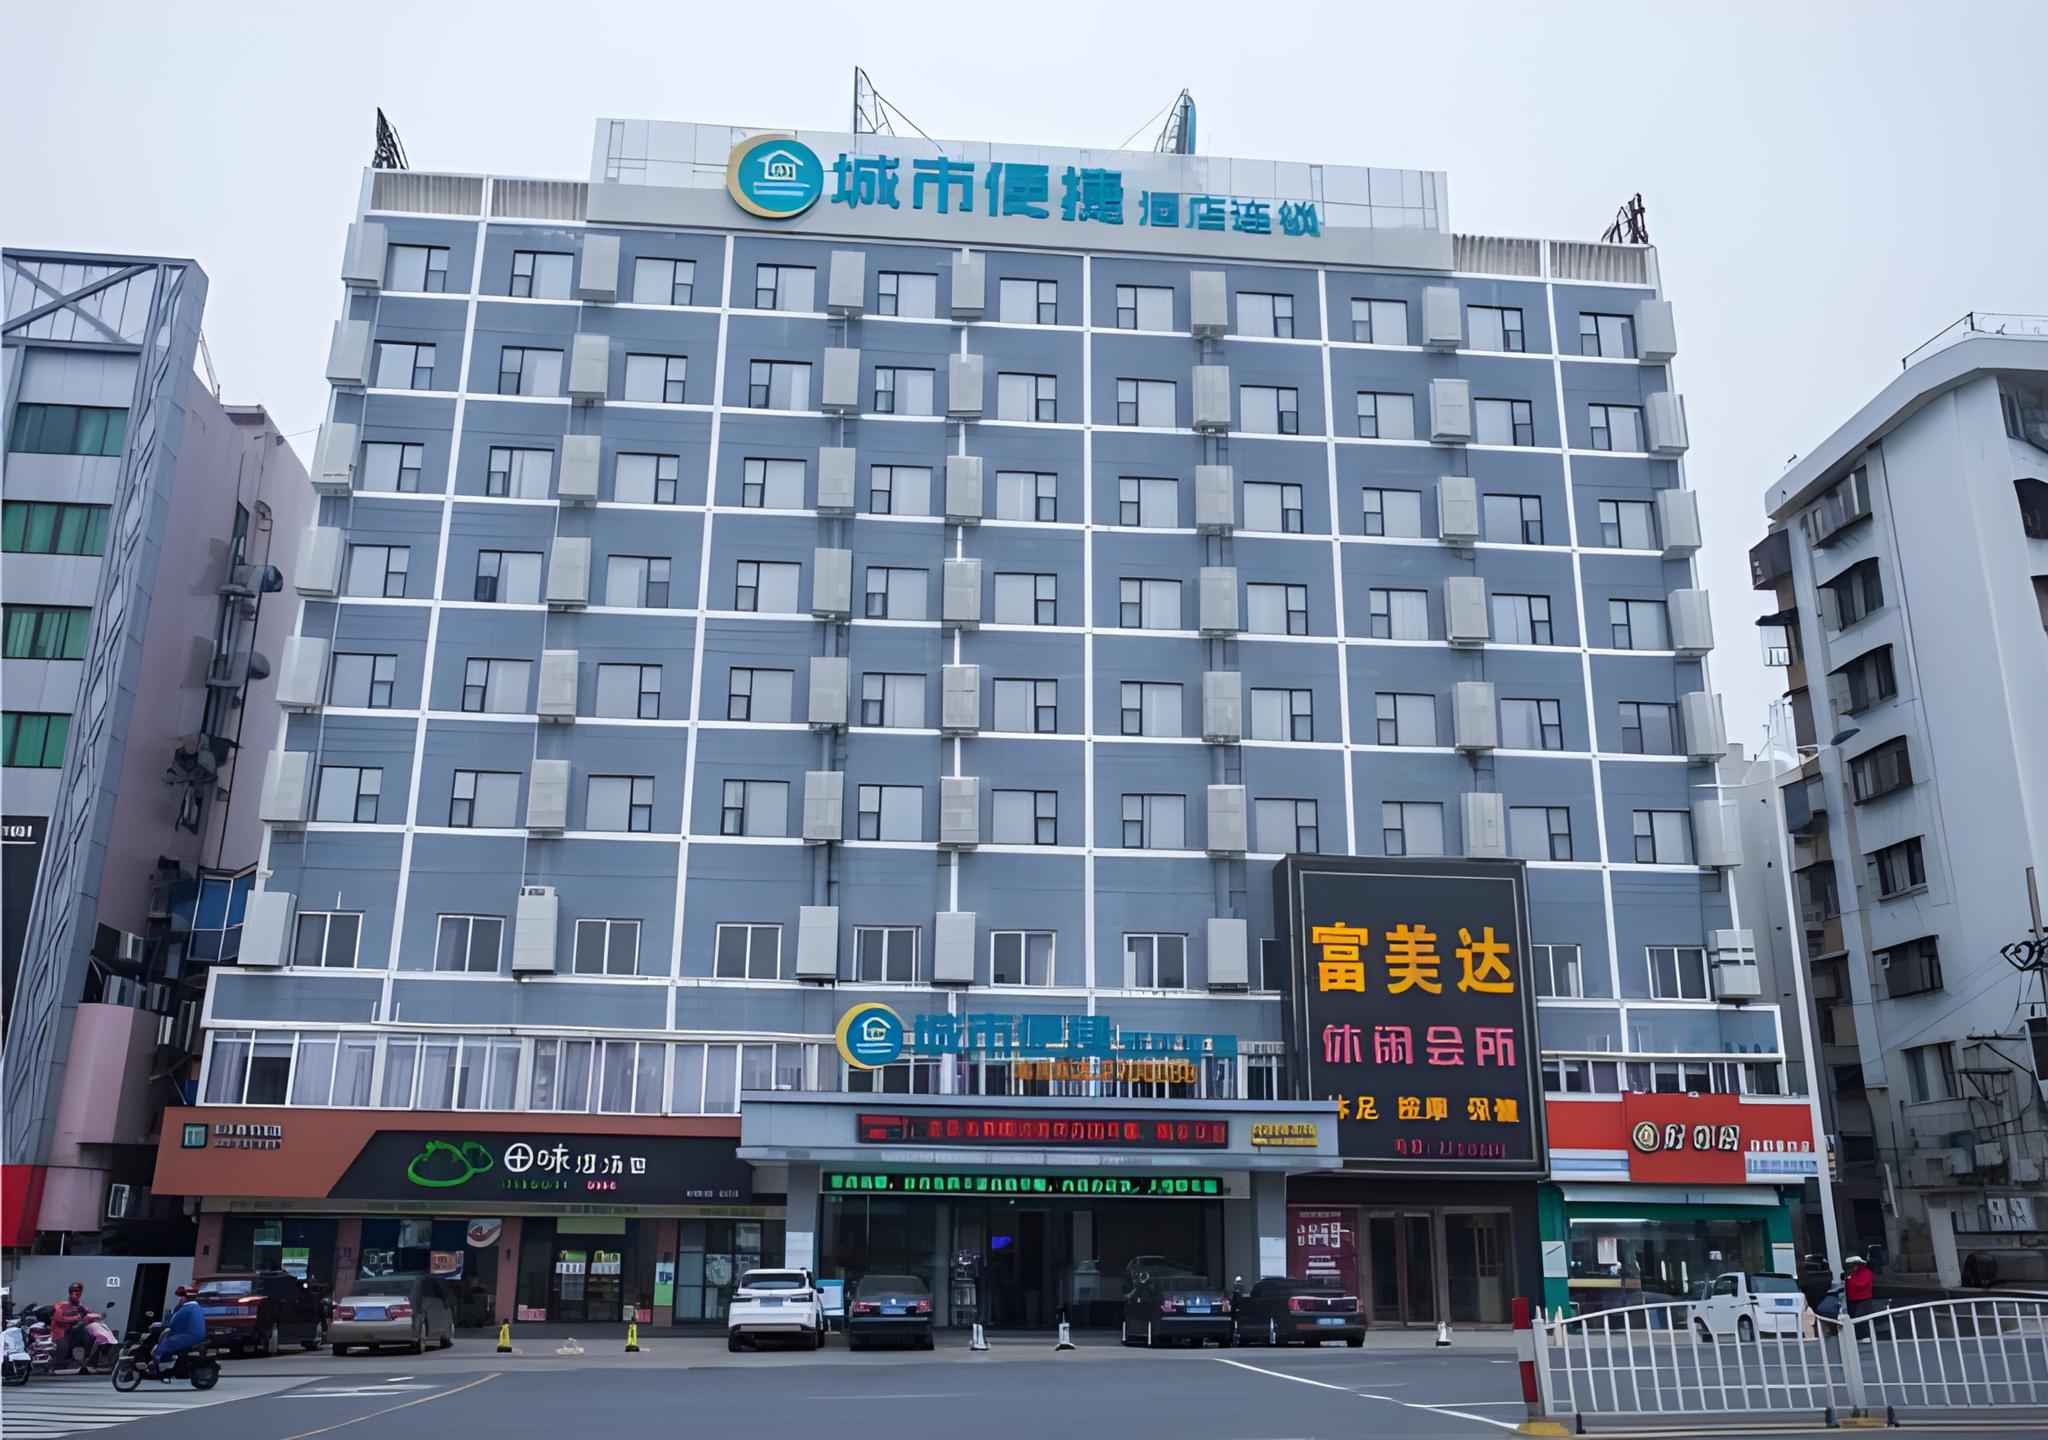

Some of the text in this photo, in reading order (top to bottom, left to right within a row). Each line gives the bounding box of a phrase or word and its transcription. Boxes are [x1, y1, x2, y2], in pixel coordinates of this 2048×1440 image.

[1311, 921, 1515, 994] 富美达
[1322, 1023, 1516, 1067] 休闲会所
